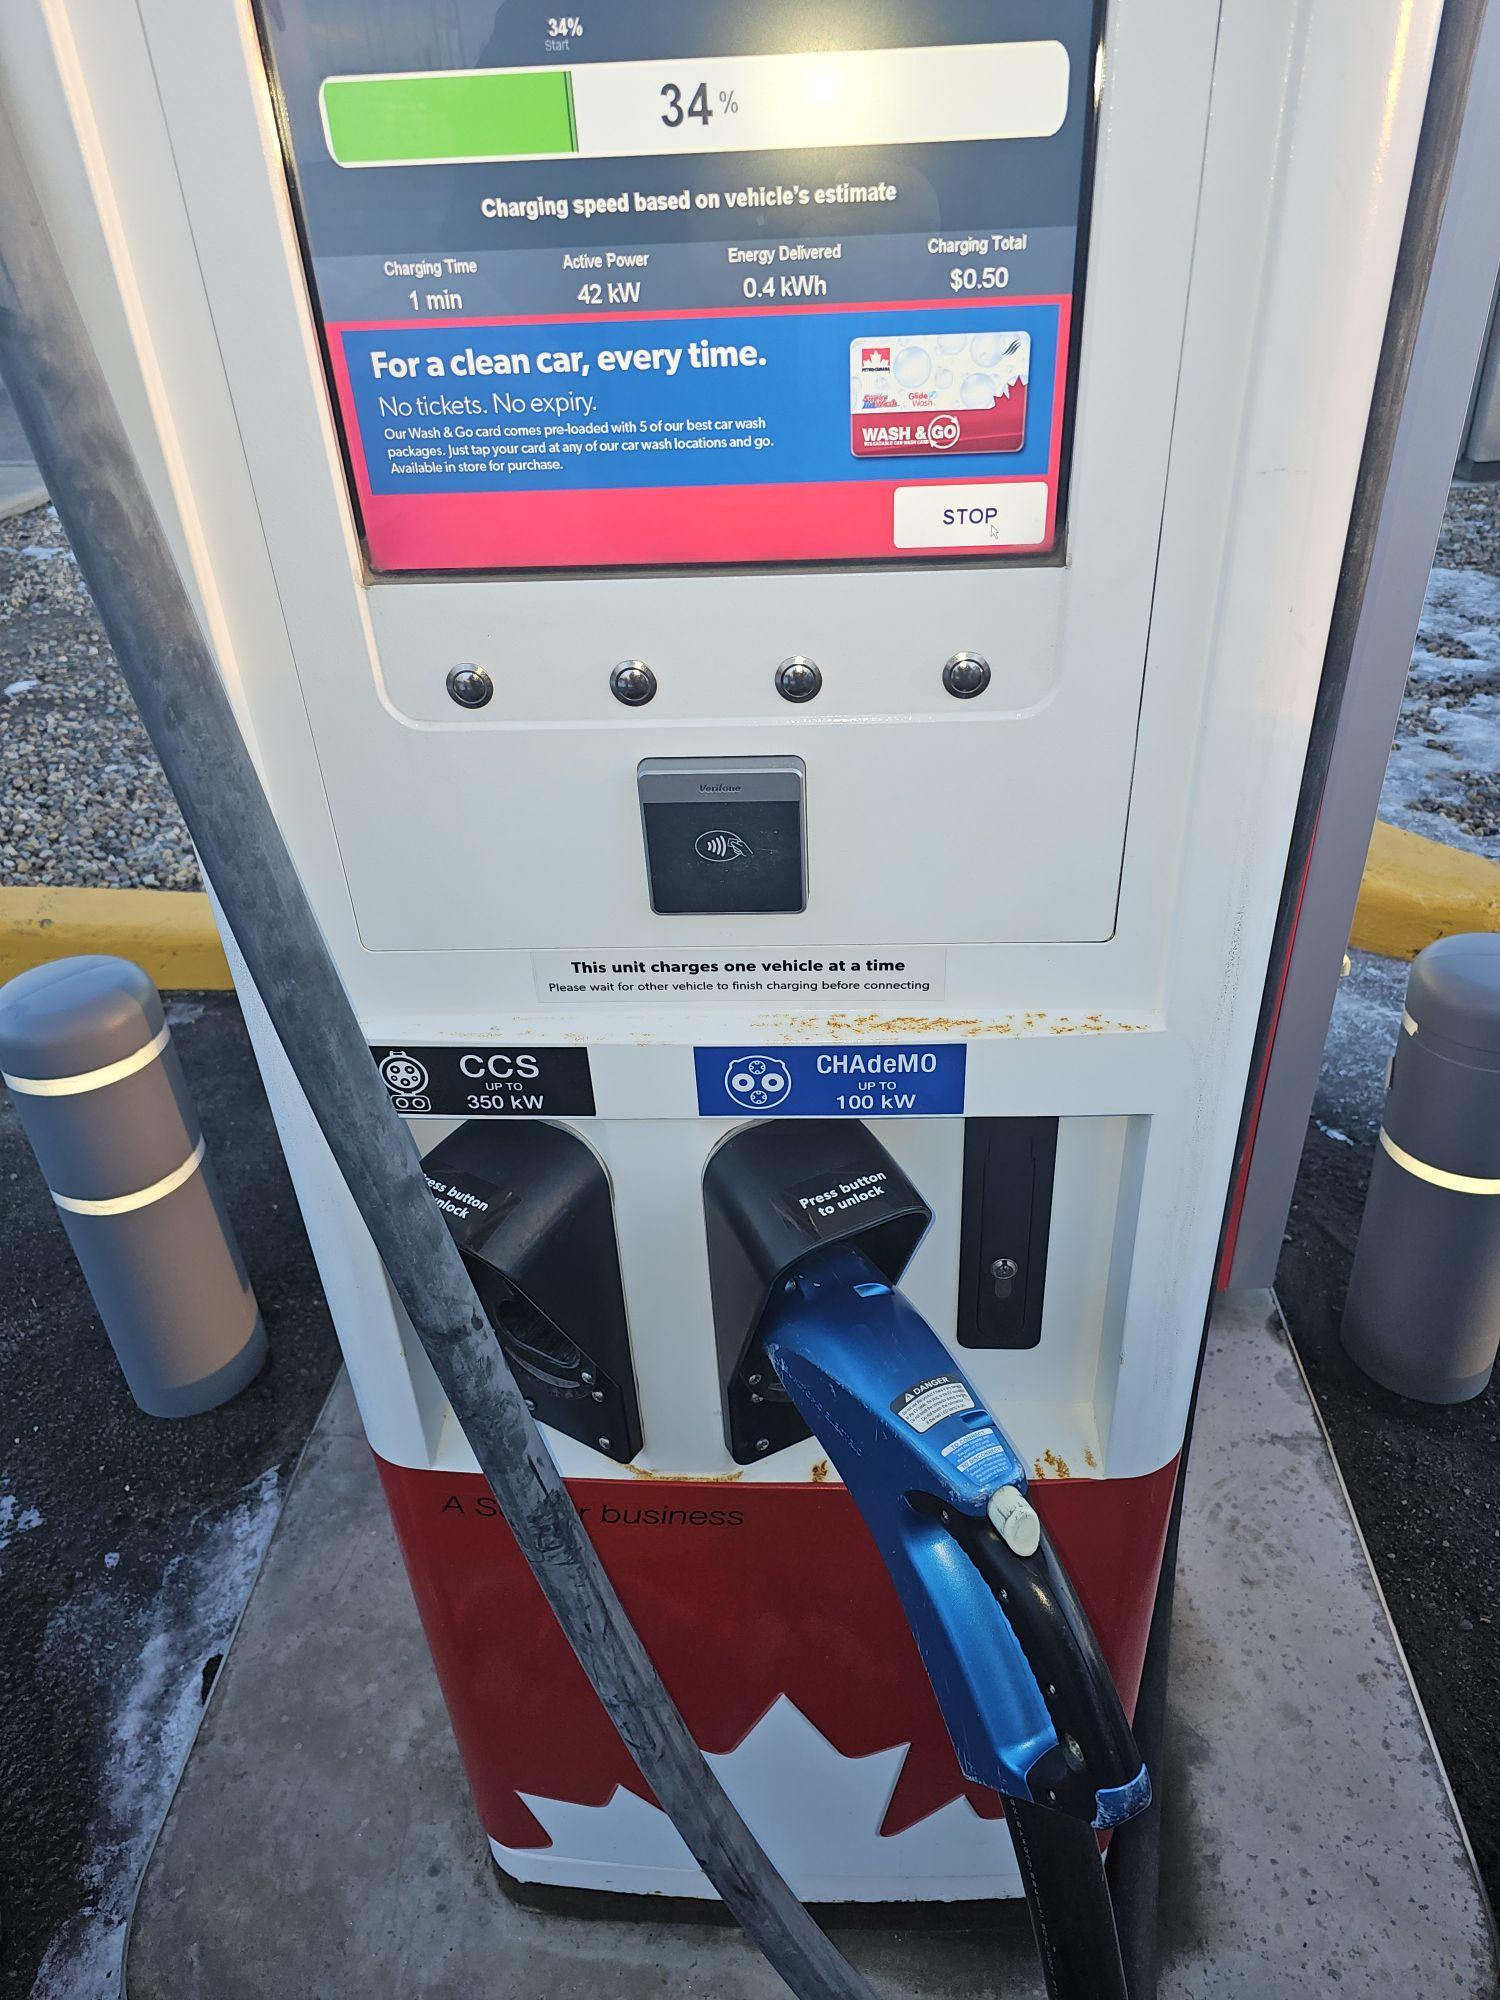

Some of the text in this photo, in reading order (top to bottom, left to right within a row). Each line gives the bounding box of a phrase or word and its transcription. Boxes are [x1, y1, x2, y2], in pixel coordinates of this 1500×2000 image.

[548, 17, 583, 38] 34%
[545, 39, 570, 52] Start
[660, 83, 713, 127] 34
[482, 182, 896, 221] Charging speed based on vehicle's estimate
[728, 244, 841, 265] Energy Delivered
[928, 234, 1027, 256] Charging Total
[384, 258, 477, 278] Charging Time
[563, 252, 649, 270] Active Power
[743, 275, 827, 298] 0.4 kWh
[950, 267, 1009, 292] $0.50
[409, 289, 463, 310] 1 min
[578, 282, 640, 304] 42 kW
[370, 339, 767, 379] For a clean car, every time.
[378, 390, 597, 417] No tickets. No expiry.
[384, 417, 766, 441] Our Wash & Go card comes pre-loaded with 5 of our best car wash
[862, 424, 957, 441] WASH & GO
[388, 435, 775, 461] packages. Just tap your card at any of our car wash locations and go.
[391, 459, 564, 475] Available in store for purchase.
[943, 508, 998, 525] STOP
[700, 784, 742, 793] Verifone
[571, 959, 906, 975] This unit charges one vehicle at a time
[549, 981, 930, 992] Please wait for other vehicle to finish charging before connecting
[459, 1054, 540, 1079] CCS
[816, 1053, 938, 1075] CHAdeMO
[485, 1082, 523, 1091] UP TO
[858, 1081, 897, 1091] UP TO
[467, 1095, 544, 1110] 350 kW
[836, 1094, 916, 1110] 100 kW
[424, 1174, 488, 1211] ess button
[799, 1171, 887, 1211] Press button
[435, 1198, 469, 1219] nlock
[818, 1186, 885, 1218] to unlock
[913, 1376, 950, 1395] DANGER
[442, 1496, 465, 1514] A
[601, 1504, 744, 1526] business
